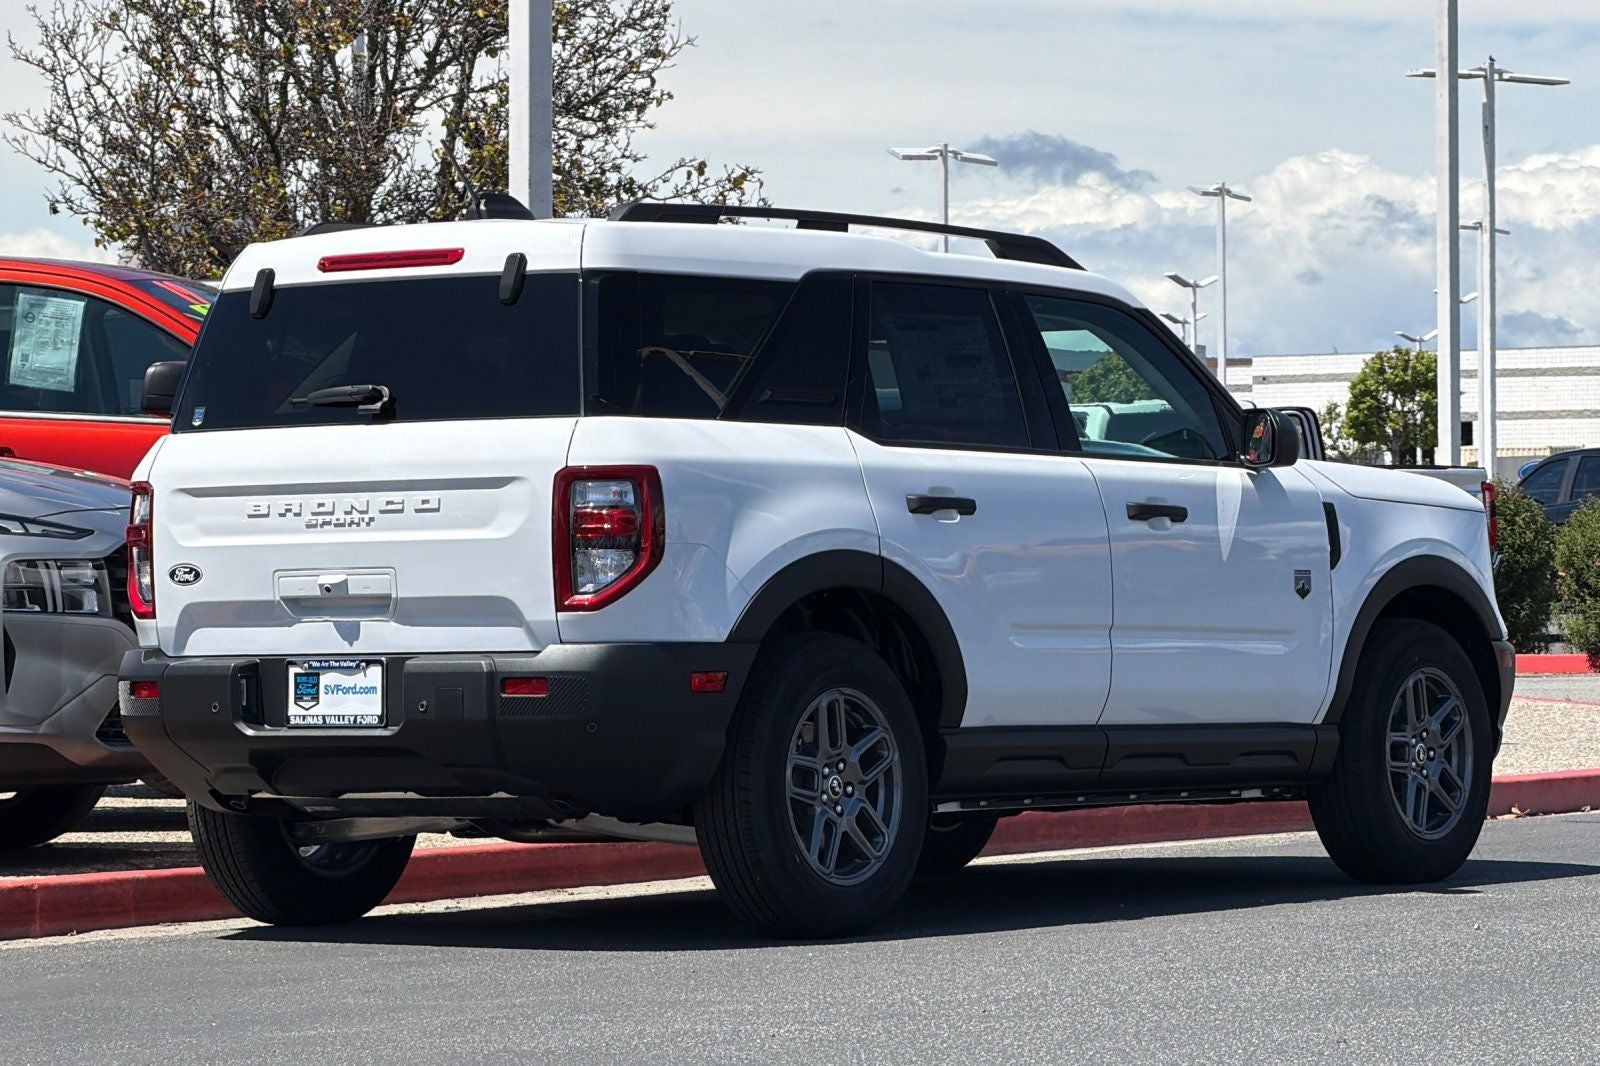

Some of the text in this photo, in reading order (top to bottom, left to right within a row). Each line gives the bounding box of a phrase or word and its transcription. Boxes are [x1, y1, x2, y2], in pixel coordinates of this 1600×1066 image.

[247, 497, 441, 519] BRONCO
[305, 516, 376, 529] SPORT
[174, 567, 196, 582] Ford
[340, 661, 360, 669] Valley"
[296, 683, 318, 695] Ford
[323, 683, 378, 696] SVFord.com
[290, 715, 379, 725] SALINAS VALLEY FORD
